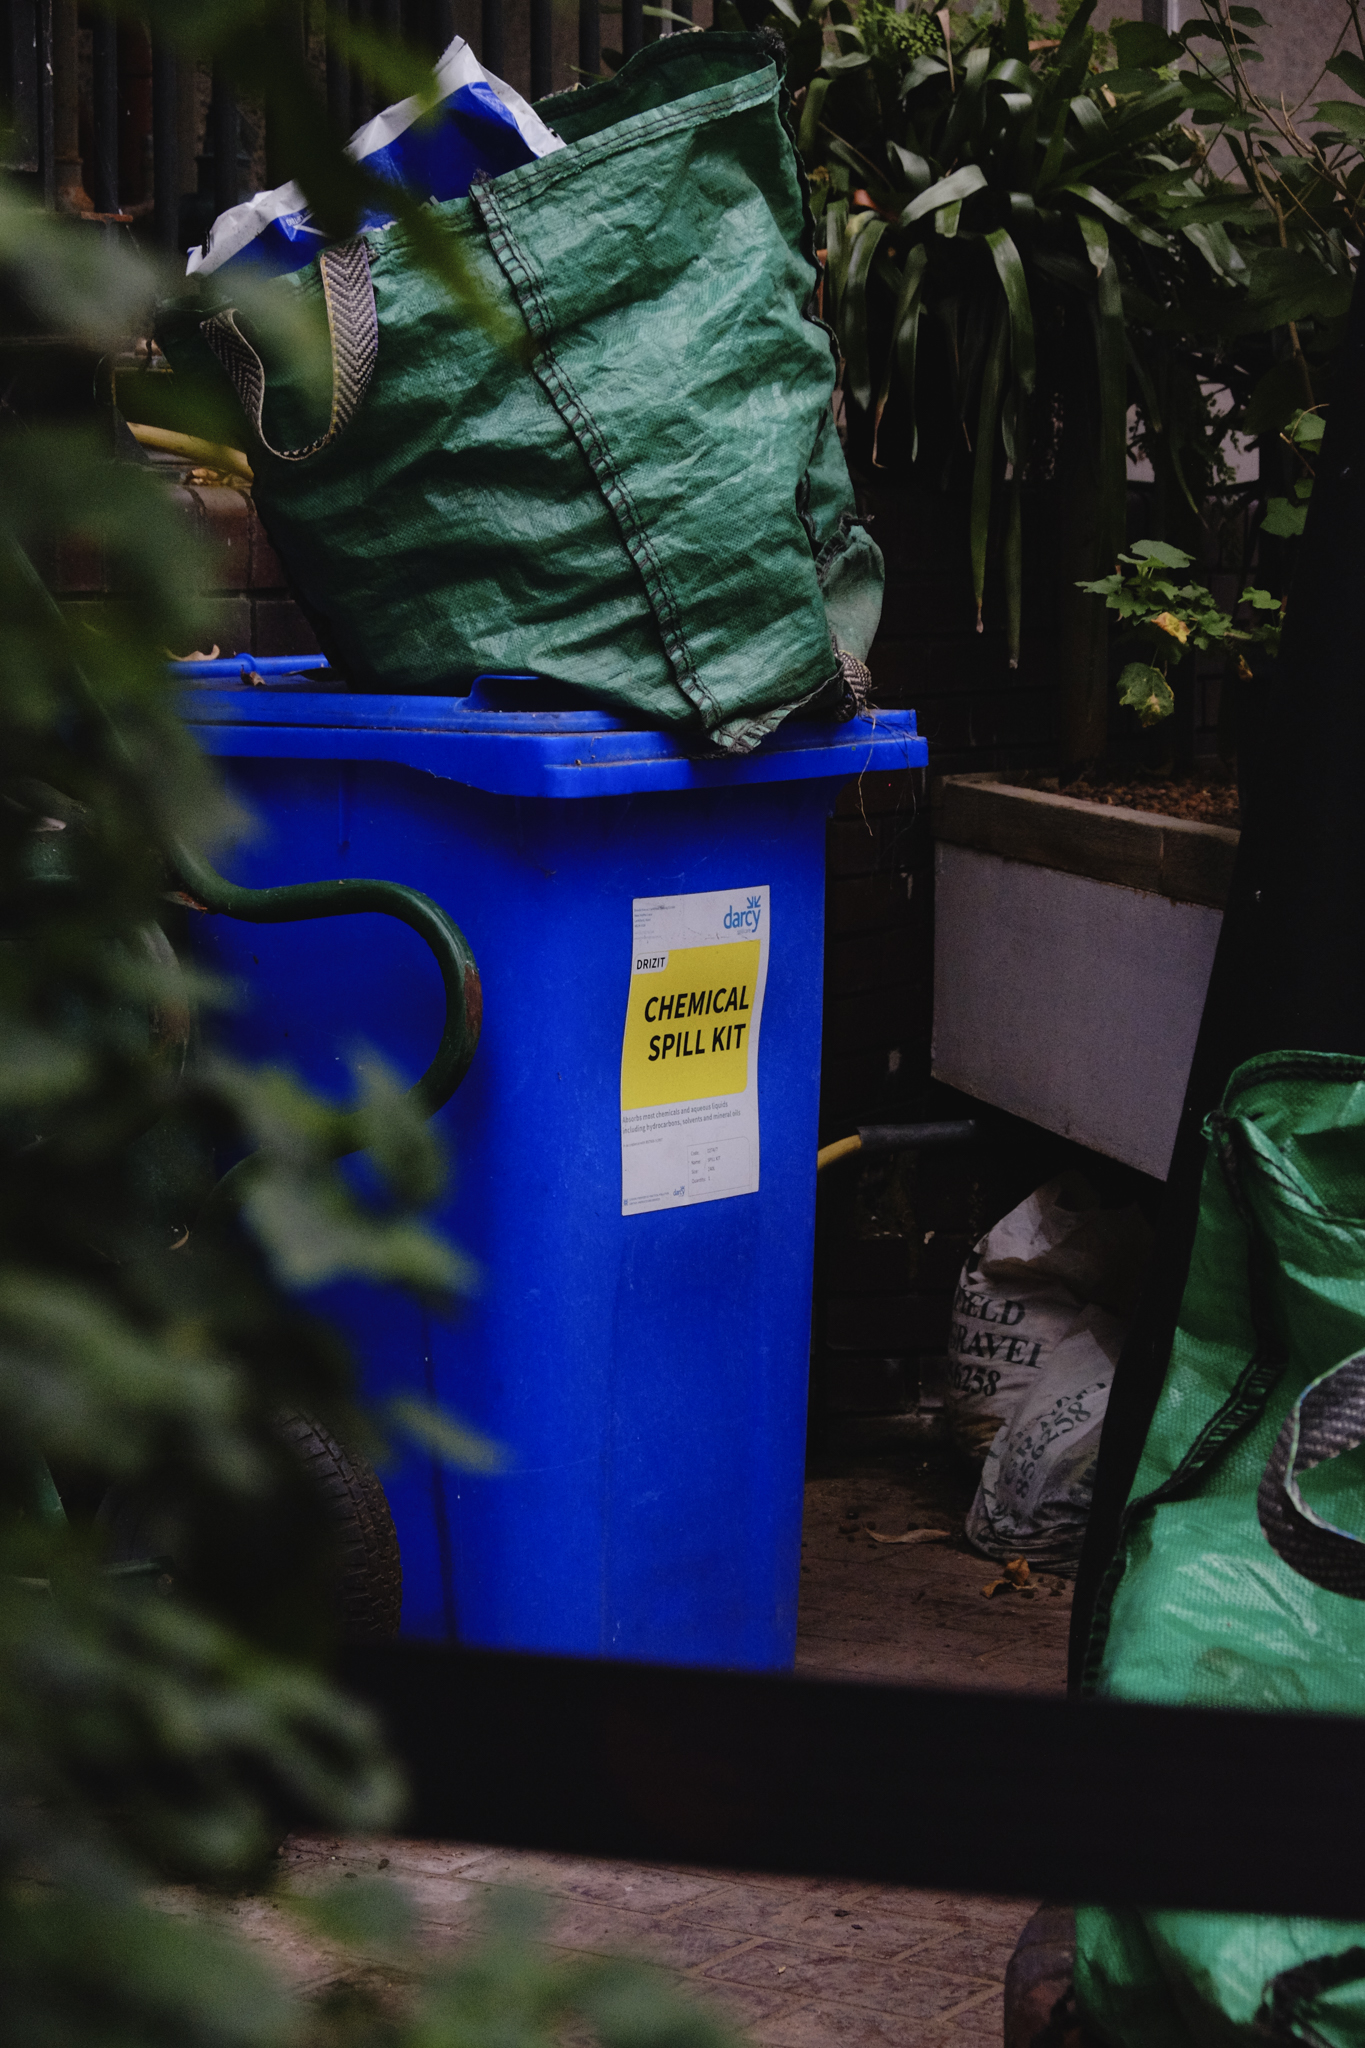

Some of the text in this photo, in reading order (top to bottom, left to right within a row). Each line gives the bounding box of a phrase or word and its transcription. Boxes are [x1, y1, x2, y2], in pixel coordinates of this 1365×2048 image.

[724, 905, 761, 933] darcy
[636, 957, 666, 970] DRIZIT
[644, 985, 749, 1023] CHEMICAL
[648, 1023, 746, 1062] SPILL KIT
[622, 1101, 728, 1123] Absorbs most chemicals and aqueous liquids
[623, 1109, 741, 1134] including hydrocarbons, solvents and mineral oils
[1015, 1401, 1091, 1499] 856258
